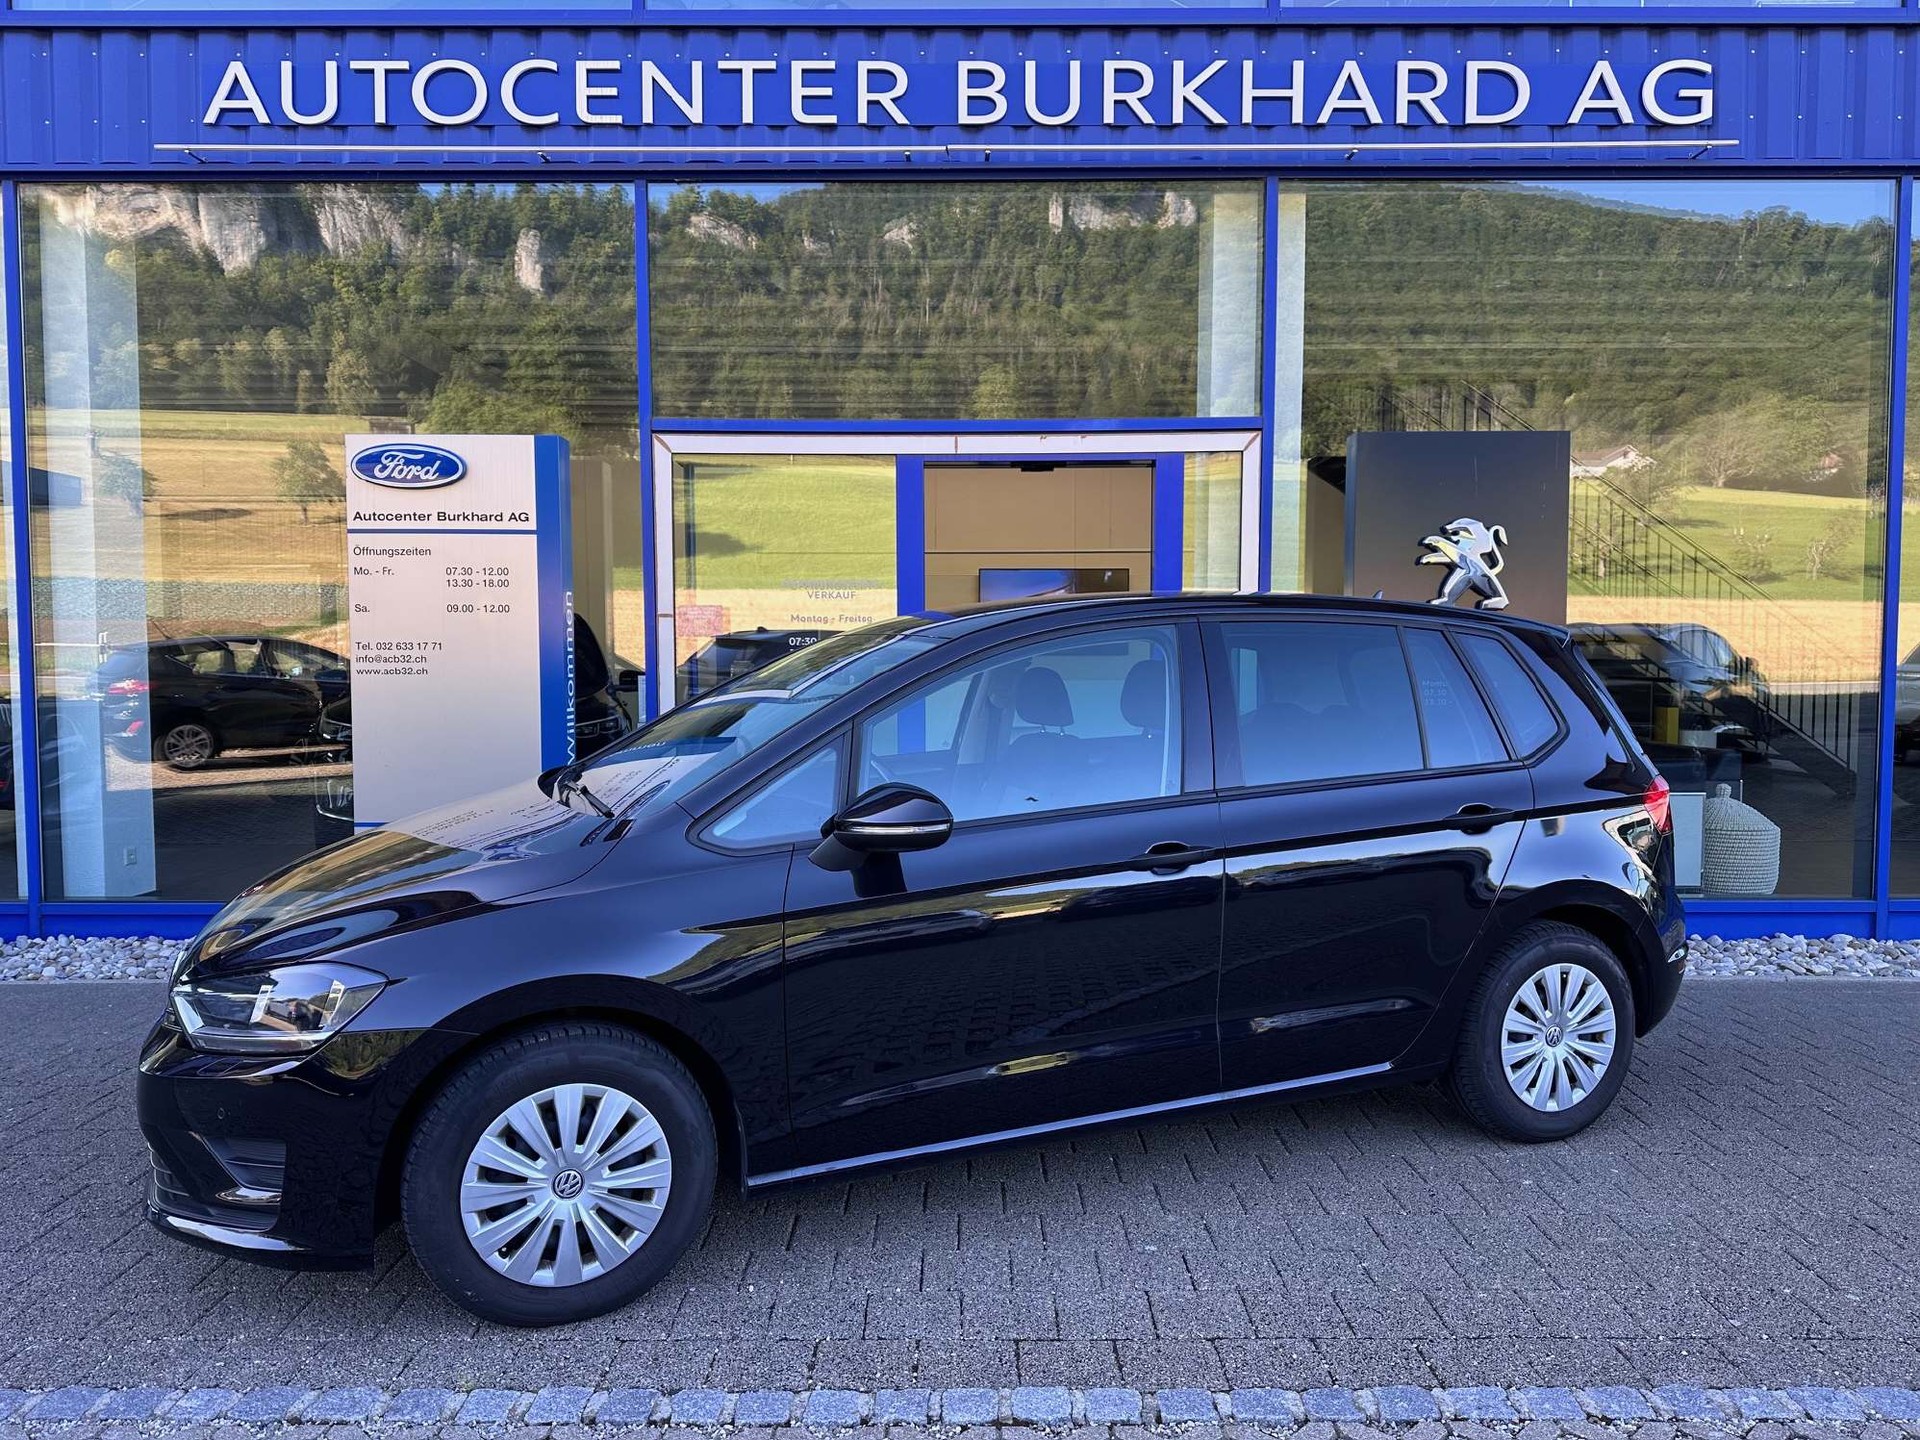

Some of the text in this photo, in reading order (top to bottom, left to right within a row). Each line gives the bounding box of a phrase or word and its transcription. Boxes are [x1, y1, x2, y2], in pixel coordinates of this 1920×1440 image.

[203, 59, 1715, 126] AUTOCENTER BURKHARD AG
[374, 451, 440, 480] Ford
[353, 511, 530, 522] Autocenter Burkhard AG
[353, 545, 431, 558] Öffnungszeiten
[353, 567, 373, 576] Mo.
[382, 567, 395, 576] Fr.
[445, 567, 473, 576] 07.30
[482, 567, 509, 576] 12.00
[446, 579, 473, 588] 13.30
[483, 579, 510, 588] 18.00
[807, 591, 857, 600] VERKAUF
[354, 604, 371, 613] Sa.
[446, 604, 474, 613] 09.00
[483, 604, 510, 613] 12.00
[790, 614, 829, 624] Montag
[839, 614, 873, 624] Freitag
[355, 642, 442, 651] Tel. 032 633 17 71
[355, 654, 427, 664] info@acb32.ch
[356, 666, 428, 675] www.acb32.ch
[565, 591, 575, 765] Willkommen
[553, 1169, 583, 1199] VW
